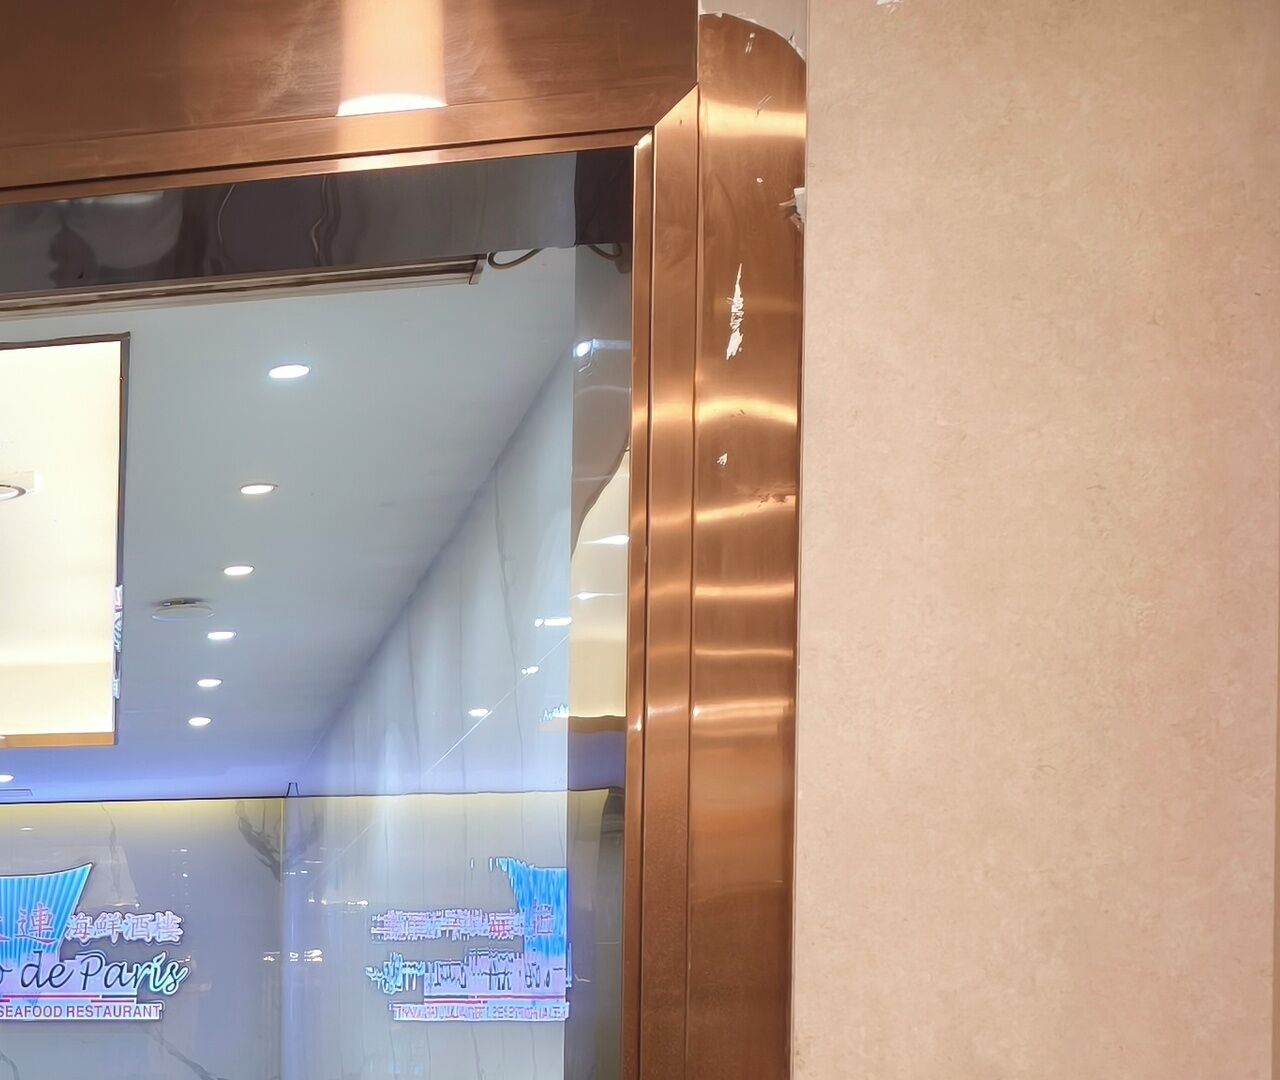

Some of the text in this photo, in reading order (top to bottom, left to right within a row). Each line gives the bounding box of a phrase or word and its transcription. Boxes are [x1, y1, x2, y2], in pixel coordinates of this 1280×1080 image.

[20, 950, 77, 988] de
[79, 950, 189, 992] Paris
[65, 1004, 161, 1019] RESTAURANT
